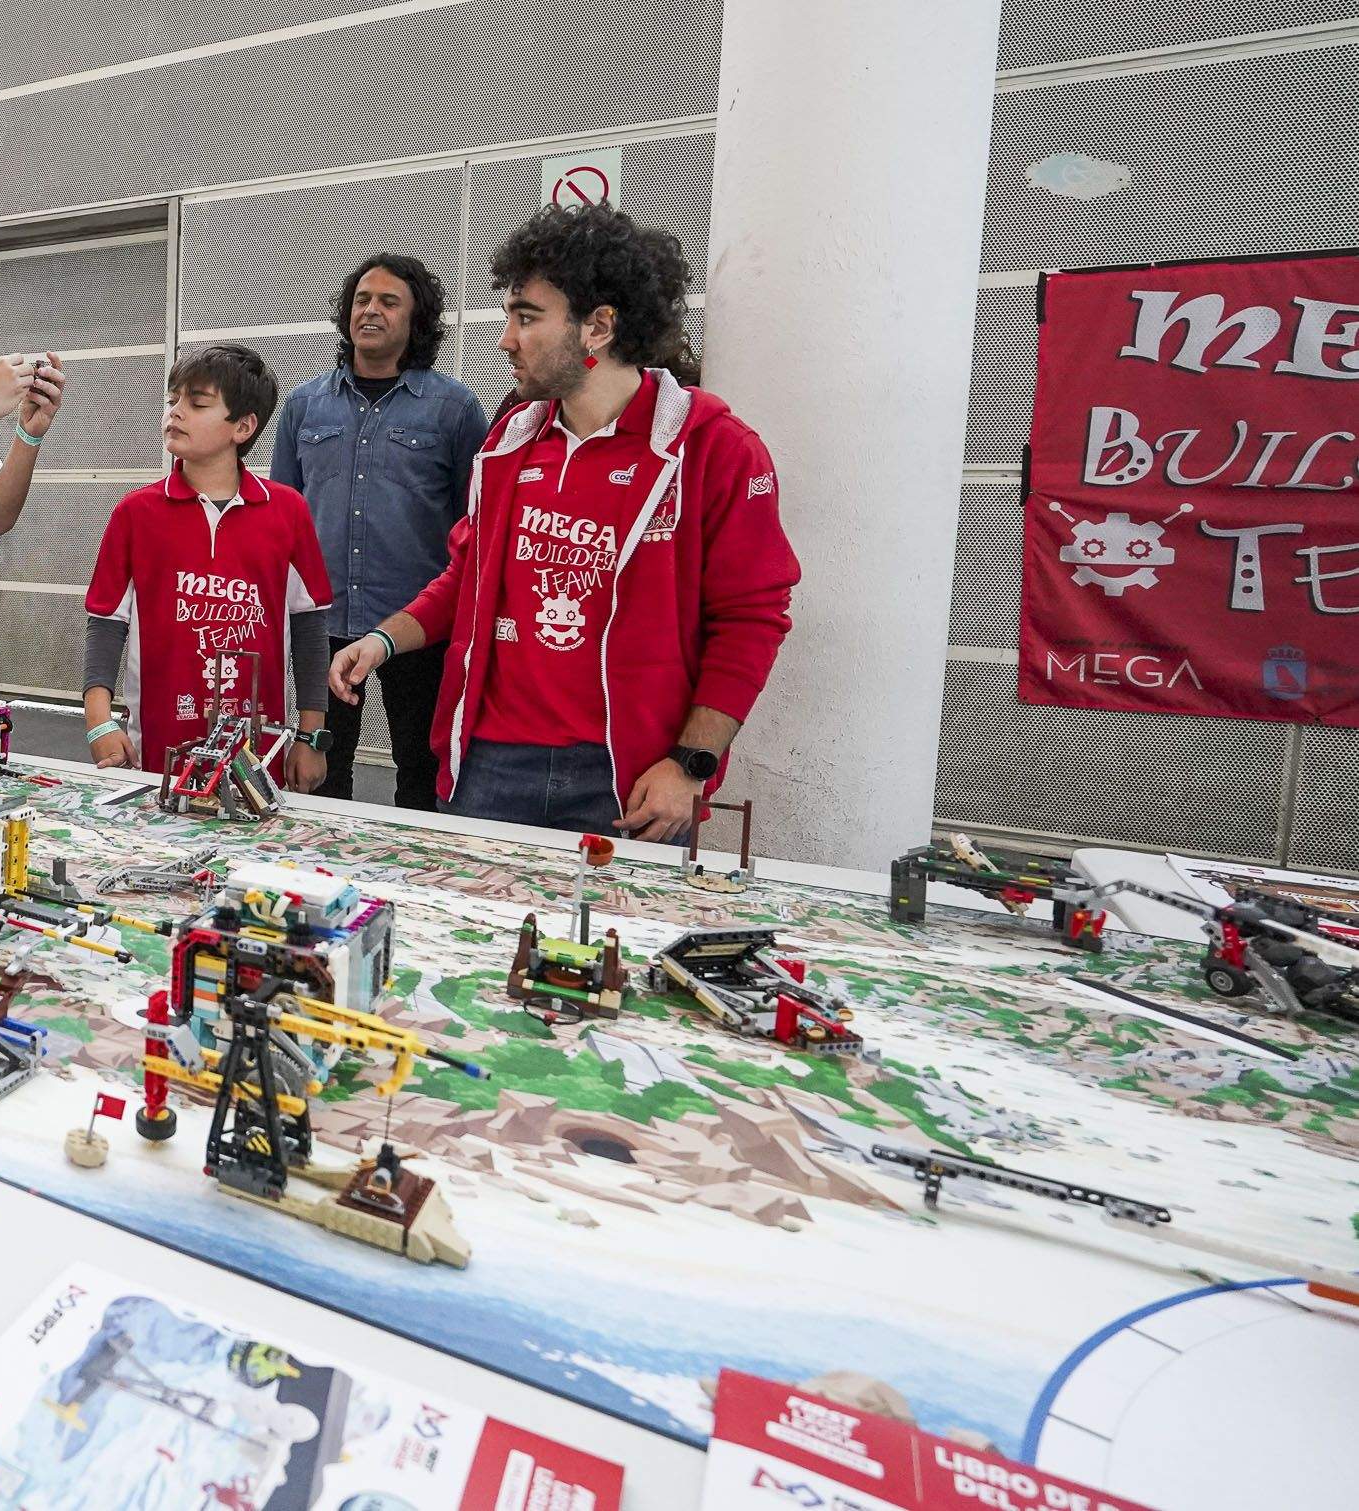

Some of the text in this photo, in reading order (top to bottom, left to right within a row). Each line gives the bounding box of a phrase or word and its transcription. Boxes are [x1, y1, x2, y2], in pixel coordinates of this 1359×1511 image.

[1118, 290, 1359, 380] ME
[1084, 406, 1359, 490] BUIL
[518, 505, 617, 552] MEGA
[515, 535, 618, 571] BUILDER
[1199, 519, 1359, 615] TE
[176, 571, 262, 607] MEGA
[533, 567, 602, 594] TEAM
[176, 598, 267, 628] BUILDER
[192, 622, 256, 650] TEAM
[496, 624, 518, 642] EGA
[1046, 650, 1204, 691] MEGA
[934, 1446, 1092, 1511] LIBRO DE
[953, 1473, 1019, 1511] DEL
